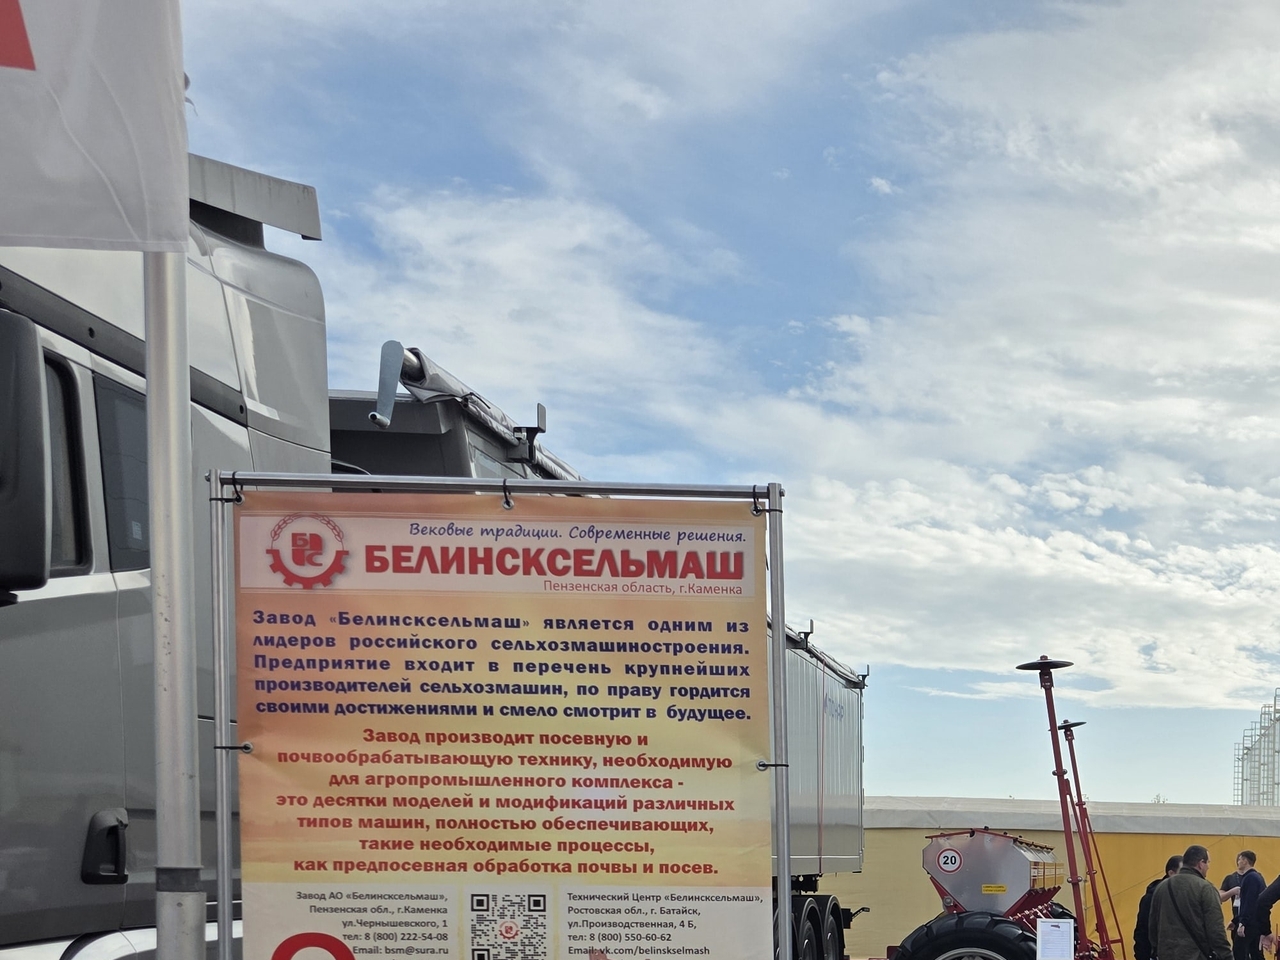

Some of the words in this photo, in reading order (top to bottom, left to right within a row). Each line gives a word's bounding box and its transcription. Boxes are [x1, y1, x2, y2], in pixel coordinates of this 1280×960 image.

[409, 522, 474, 537] Вековые
[480, 524, 562, 542] традиции.
[569, 524, 671, 543] Современные
[677, 530, 746, 545] решения.
[365, 545, 744, 580] БЕЛИНСКСЕЛЬМАШ
[543, 579, 618, 593] Пензенская
[621, 581, 676, 595] область,
[679, 582, 743, 595] г.Каменка
[253, 610, 317, 627] Завод
[329, 611, 530, 629] «Белинсксельмаш»
[543, 618, 634, 630] является
[648, 620, 713, 633] одним
[726, 621, 749, 633] из
[253, 635, 336, 650] лидеров
[349, 633, 478, 650] российского
[491, 638, 749, 656] сельхозмашиностроения.
[254, 654, 391, 672] Предприятие
[404, 660, 475, 673] входит
[488, 661, 499, 672] в
[513, 661, 612, 676] перечень
[624, 661, 750, 677] крупнейших
[254, 677, 412, 694] производителей
[420, 681, 568, 698] сельхозмашин,
[576, 685, 599, 695] по
[607, 685, 662, 698] праву
[670, 686, 750, 700] гордится
[255, 702, 329, 714] своими
[334, 703, 477, 716] достижениями
[483, 705, 494, 716] и
[499, 705, 558, 717] смело
[563, 706, 641, 720] смотрит
[646, 707, 657, 718] в
[666, 704, 751, 722] будущее.
[362, 728, 421, 745] Завод
[425, 732, 534, 746] производит
[539, 734, 632, 748] посевную
[637, 735, 649, 745] и
[277, 749, 513, 768] почвообрабатывающую
[518, 755, 598, 770] технику,
[602, 753, 733, 771] необходимую
[329, 774, 359, 786] для
[364, 774, 566, 788] агропромышленного
[571, 777, 673, 789] комплекса
[276, 795, 308, 806] это
[313, 796, 387, 808] десятки
[392, 793, 473, 809] моделей
[479, 797, 490, 808] и
[496, 795, 627, 812] модификаций
[633, 799, 735, 812] различных
[297, 817, 353, 828] типов
[358, 817, 430, 831] машин,
[435, 818, 536, 830] полностью
[542, 816, 714, 834] обеспечивающих,
[359, 839, 414, 850] такие
[420, 836, 552, 853] необходимые
[557, 840, 655, 855] процессы,
[294, 860, 328, 871] как
[333, 861, 468, 874] предпосевная
[473, 858, 572, 875] обработка
[577, 862, 637, 874] почвы
[642, 863, 654, 874] и
[659, 863, 719, 874] посев.
[943, 856, 957, 865] 20
[296, 891, 326, 901] Завод
[328, 892, 343, 900] АО
[346, 892, 448, 902] «Белинсксельмаш»,
[567, 892, 629, 900] Технический
[632, 893, 661, 903] Центр
[664, 894, 763, 903] «Белинсксельмаш»,
[309, 905, 368, 914] Пензенская
[370, 905, 395, 915] обл.,
[397, 906, 448, 914] г.Каменка
[567, 907, 621, 915] Ростовская
[624, 906, 648, 917] обл.,
[659, 906, 701, 916] Батайск,
[342, 919, 439, 929] ул.Чернышевского,
[567, 920, 677, 930] ул.Производственная,
[679, 920, 686, 928] 4
[688, 920, 697, 930] Б,
[342, 933, 362, 941] тел:
[373, 932, 398, 942] (800)
[400, 933, 449, 941] 222-54-08
[567, 934, 587, 942] тел:
[589, 933, 596, 942] 8
[597, 933, 622, 943] (800)
[624, 933, 672, 942] 550-60-62
[353, 946, 382, 954] Email:
[384, 946, 449, 955] bsm@sura.ru
[568, 946, 598, 955] Email:
[599, 946, 710, 956] vk.com/belinskselmash
